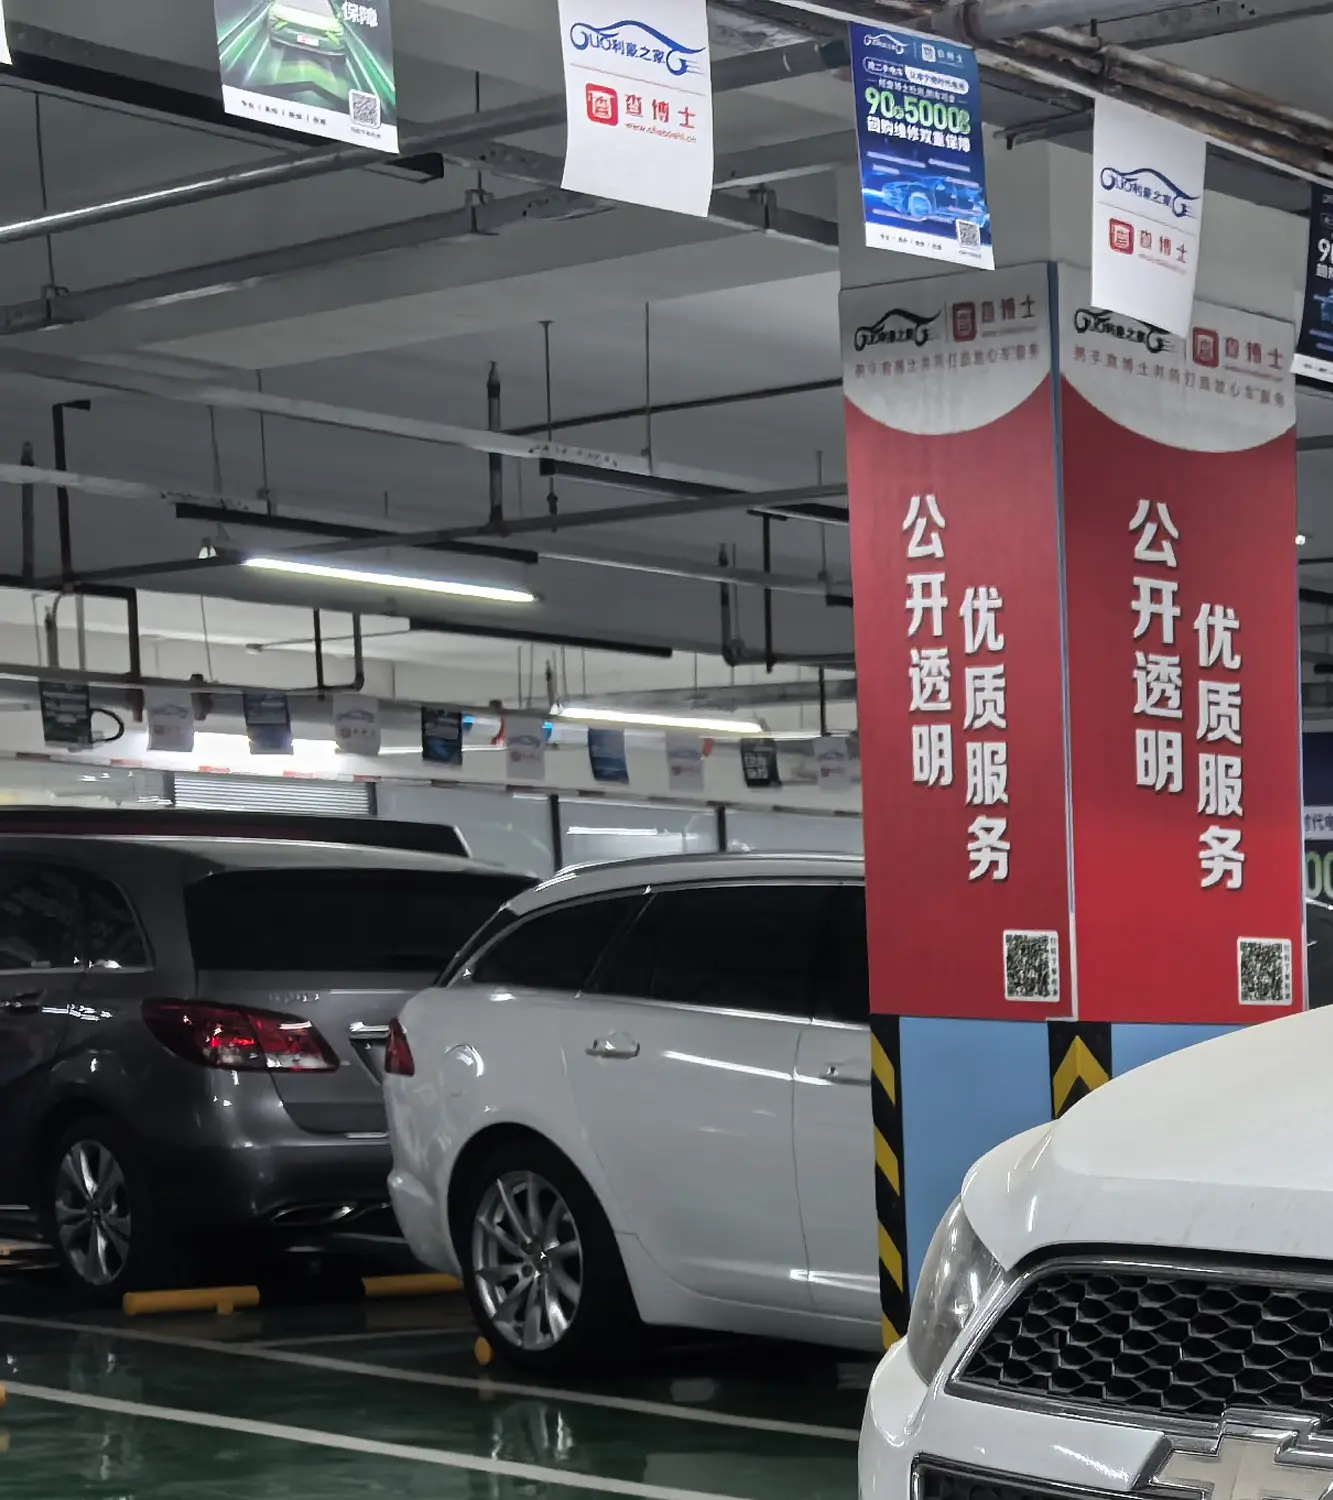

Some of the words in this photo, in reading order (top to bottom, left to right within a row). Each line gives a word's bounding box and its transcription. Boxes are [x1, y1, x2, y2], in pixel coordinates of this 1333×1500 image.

[903, 493, 953, 787] 公开透明
[959, 584, 1011, 881] 优质服务
[1128, 498, 1183, 793] 公开透明
[1193, 603, 1245, 890] 优质服务
